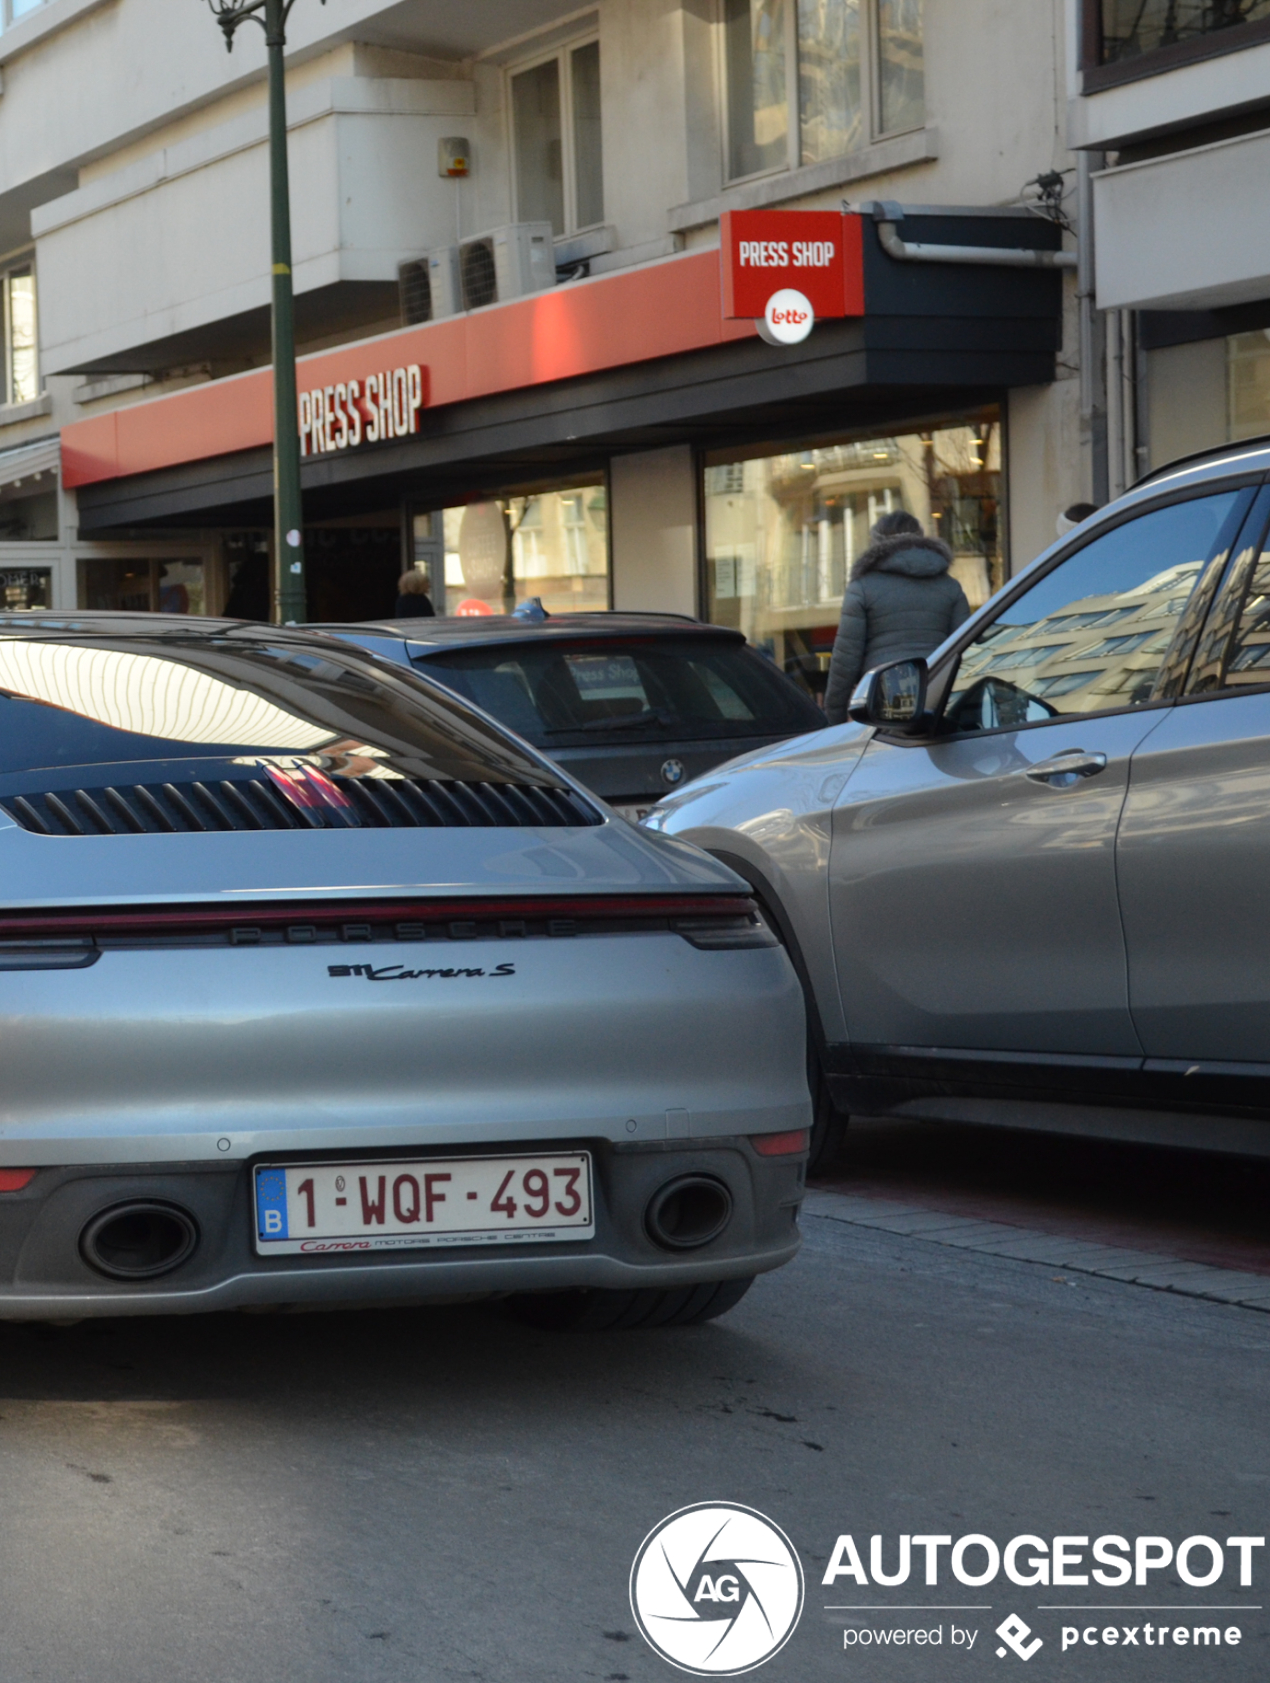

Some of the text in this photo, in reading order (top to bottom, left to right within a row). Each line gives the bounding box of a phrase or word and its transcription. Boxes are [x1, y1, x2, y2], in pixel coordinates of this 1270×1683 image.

[739, 241, 834, 267] PRESS SHOP
[772, 308, 808, 324] Lotto
[299, 364, 422, 457] PRESS SHOP
[230, 920, 577, 945] PORSCHE
[327, 963, 516, 981] 911 Carrera S
[265, 1210, 281, 1233] B
[300, 1232, 556, 1252] Carrera MOTORS PORSCHE CENTRE
